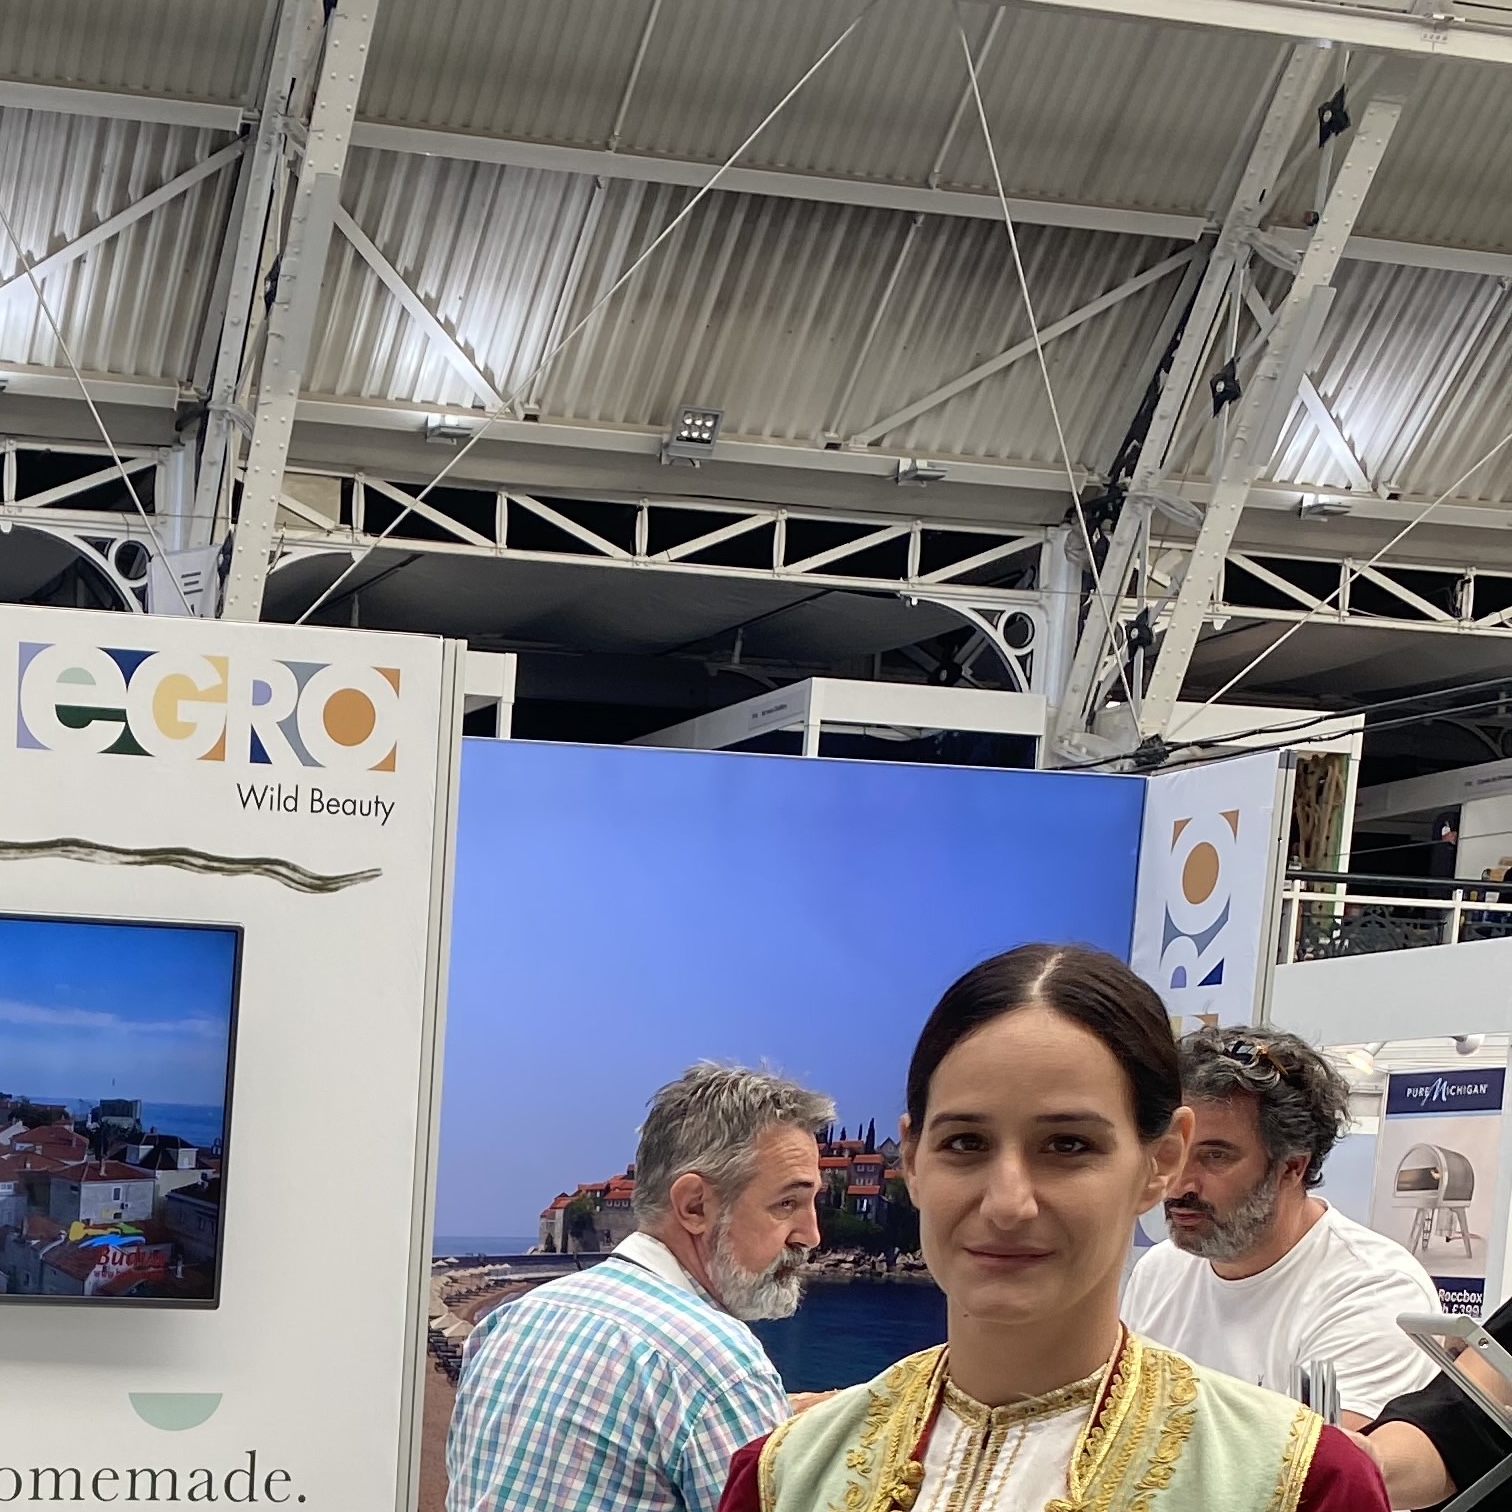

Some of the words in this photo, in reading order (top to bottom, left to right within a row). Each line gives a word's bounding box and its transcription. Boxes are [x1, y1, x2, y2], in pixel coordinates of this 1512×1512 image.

[236, 782, 299, 813] Wild
[310, 787, 396, 827] Beauty
[1421, 1077, 1488, 1106] MICHIGAN
[1439, 1288, 1483, 1304] Roccbox
